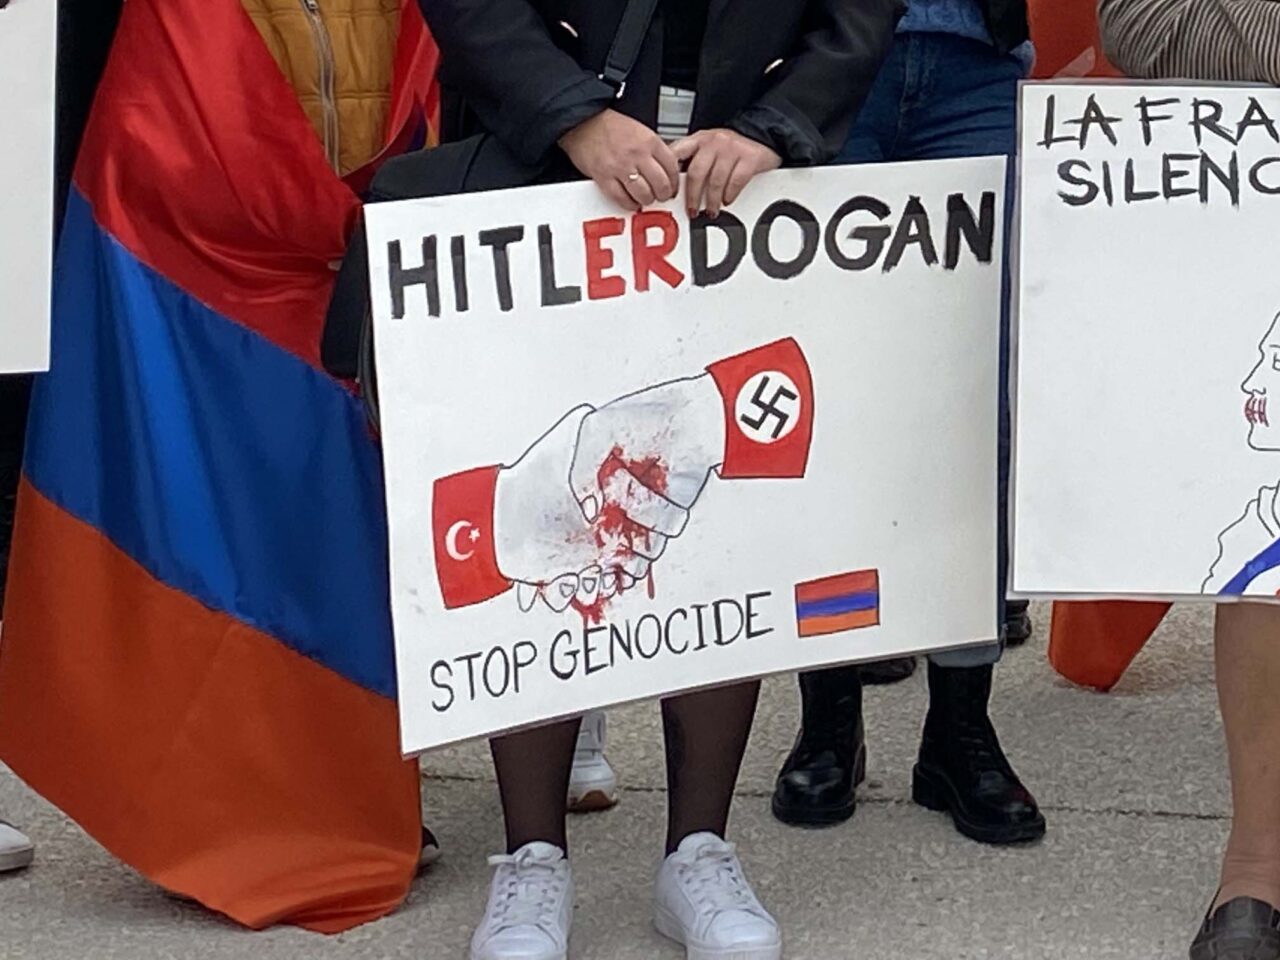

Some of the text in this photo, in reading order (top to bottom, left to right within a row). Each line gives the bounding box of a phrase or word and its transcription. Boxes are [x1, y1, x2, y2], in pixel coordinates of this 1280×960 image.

[1037, 94, 1121, 149] LA
[387, 190, 996, 319] HITLERDOGAN
[429, 591, 775, 712] STOP GENOCIDE
